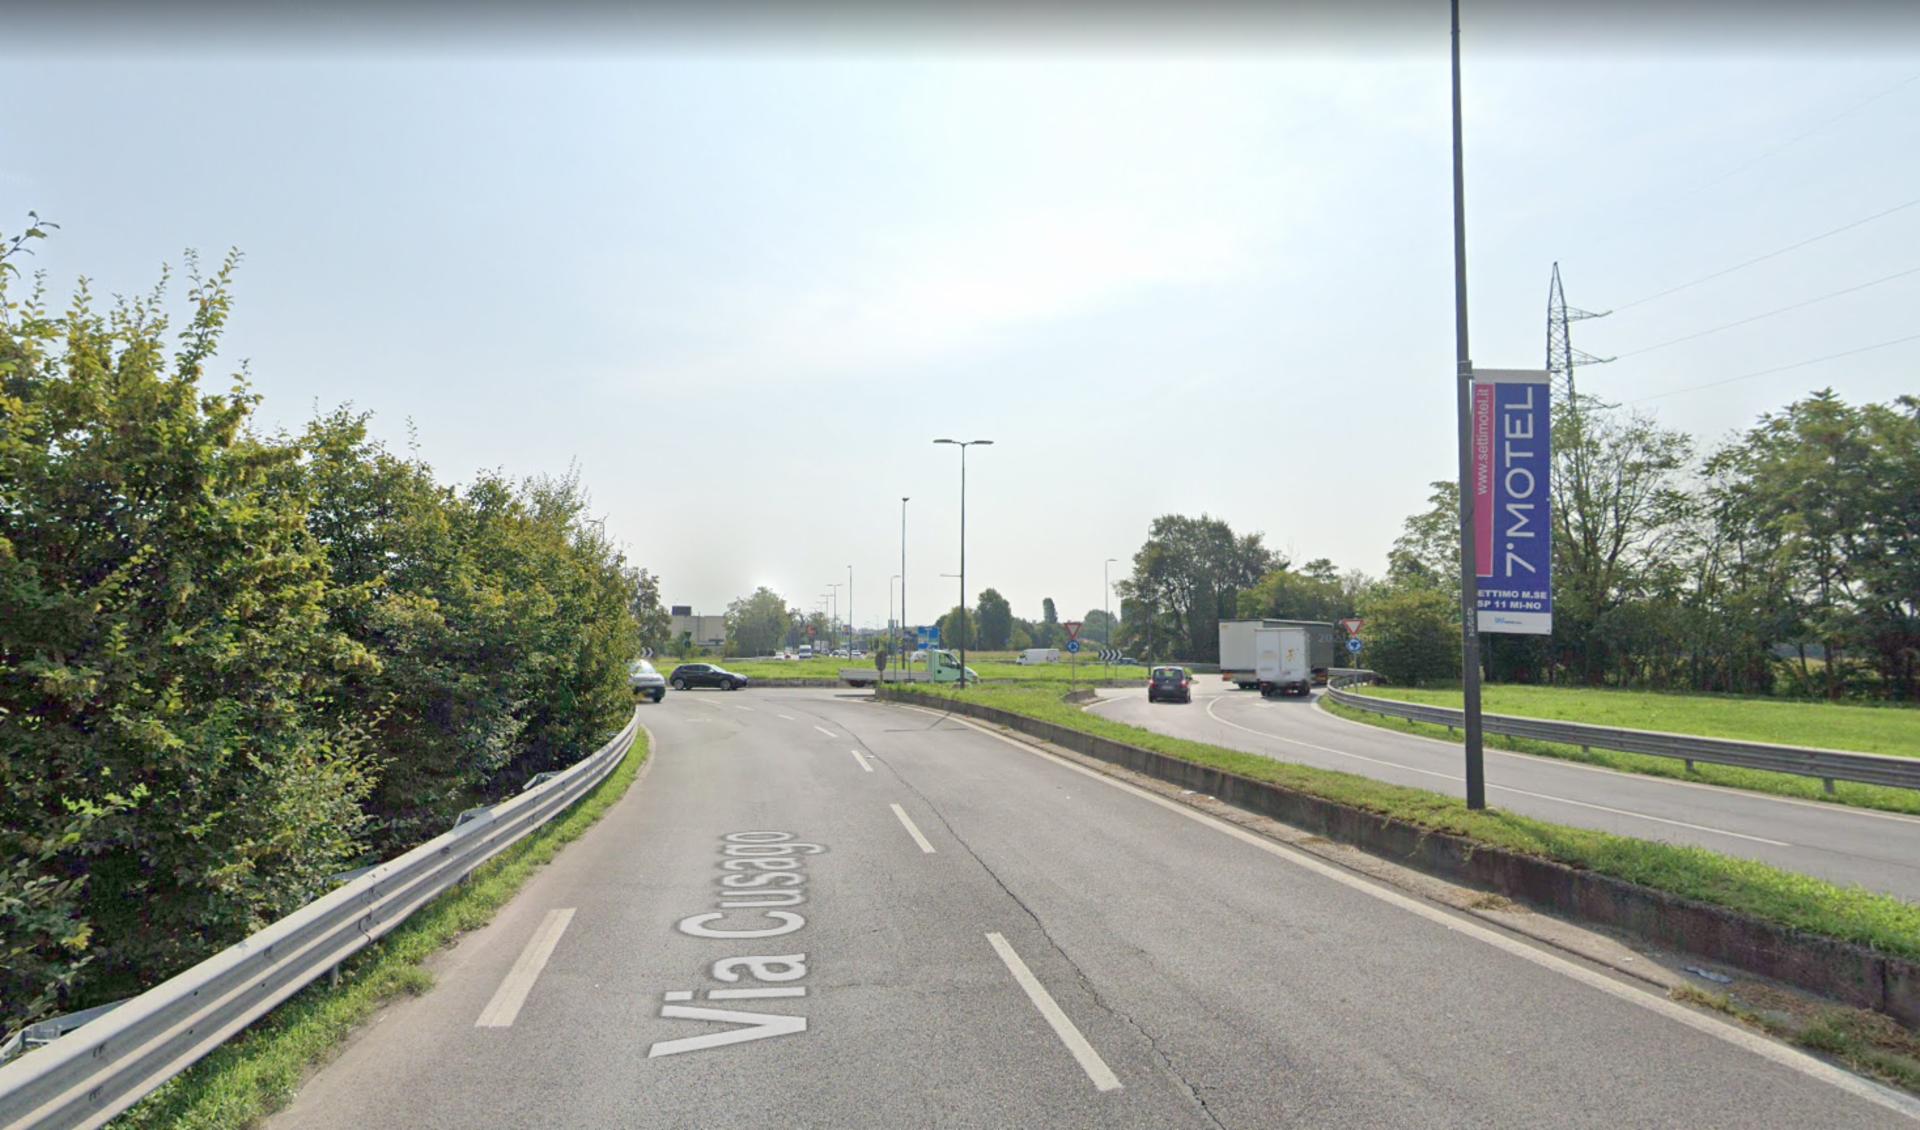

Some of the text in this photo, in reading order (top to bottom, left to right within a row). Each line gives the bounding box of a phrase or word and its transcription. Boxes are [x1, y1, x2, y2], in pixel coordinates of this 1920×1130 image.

[1477, 388, 1490, 496] www.settimotel.it
[1477, 589, 1519, 599] ETTIMO
[1494, 600, 1506, 609] 11
[1509, 601, 1542, 610] MI-NO
[648, 831, 828, 1059] Via Cusago
